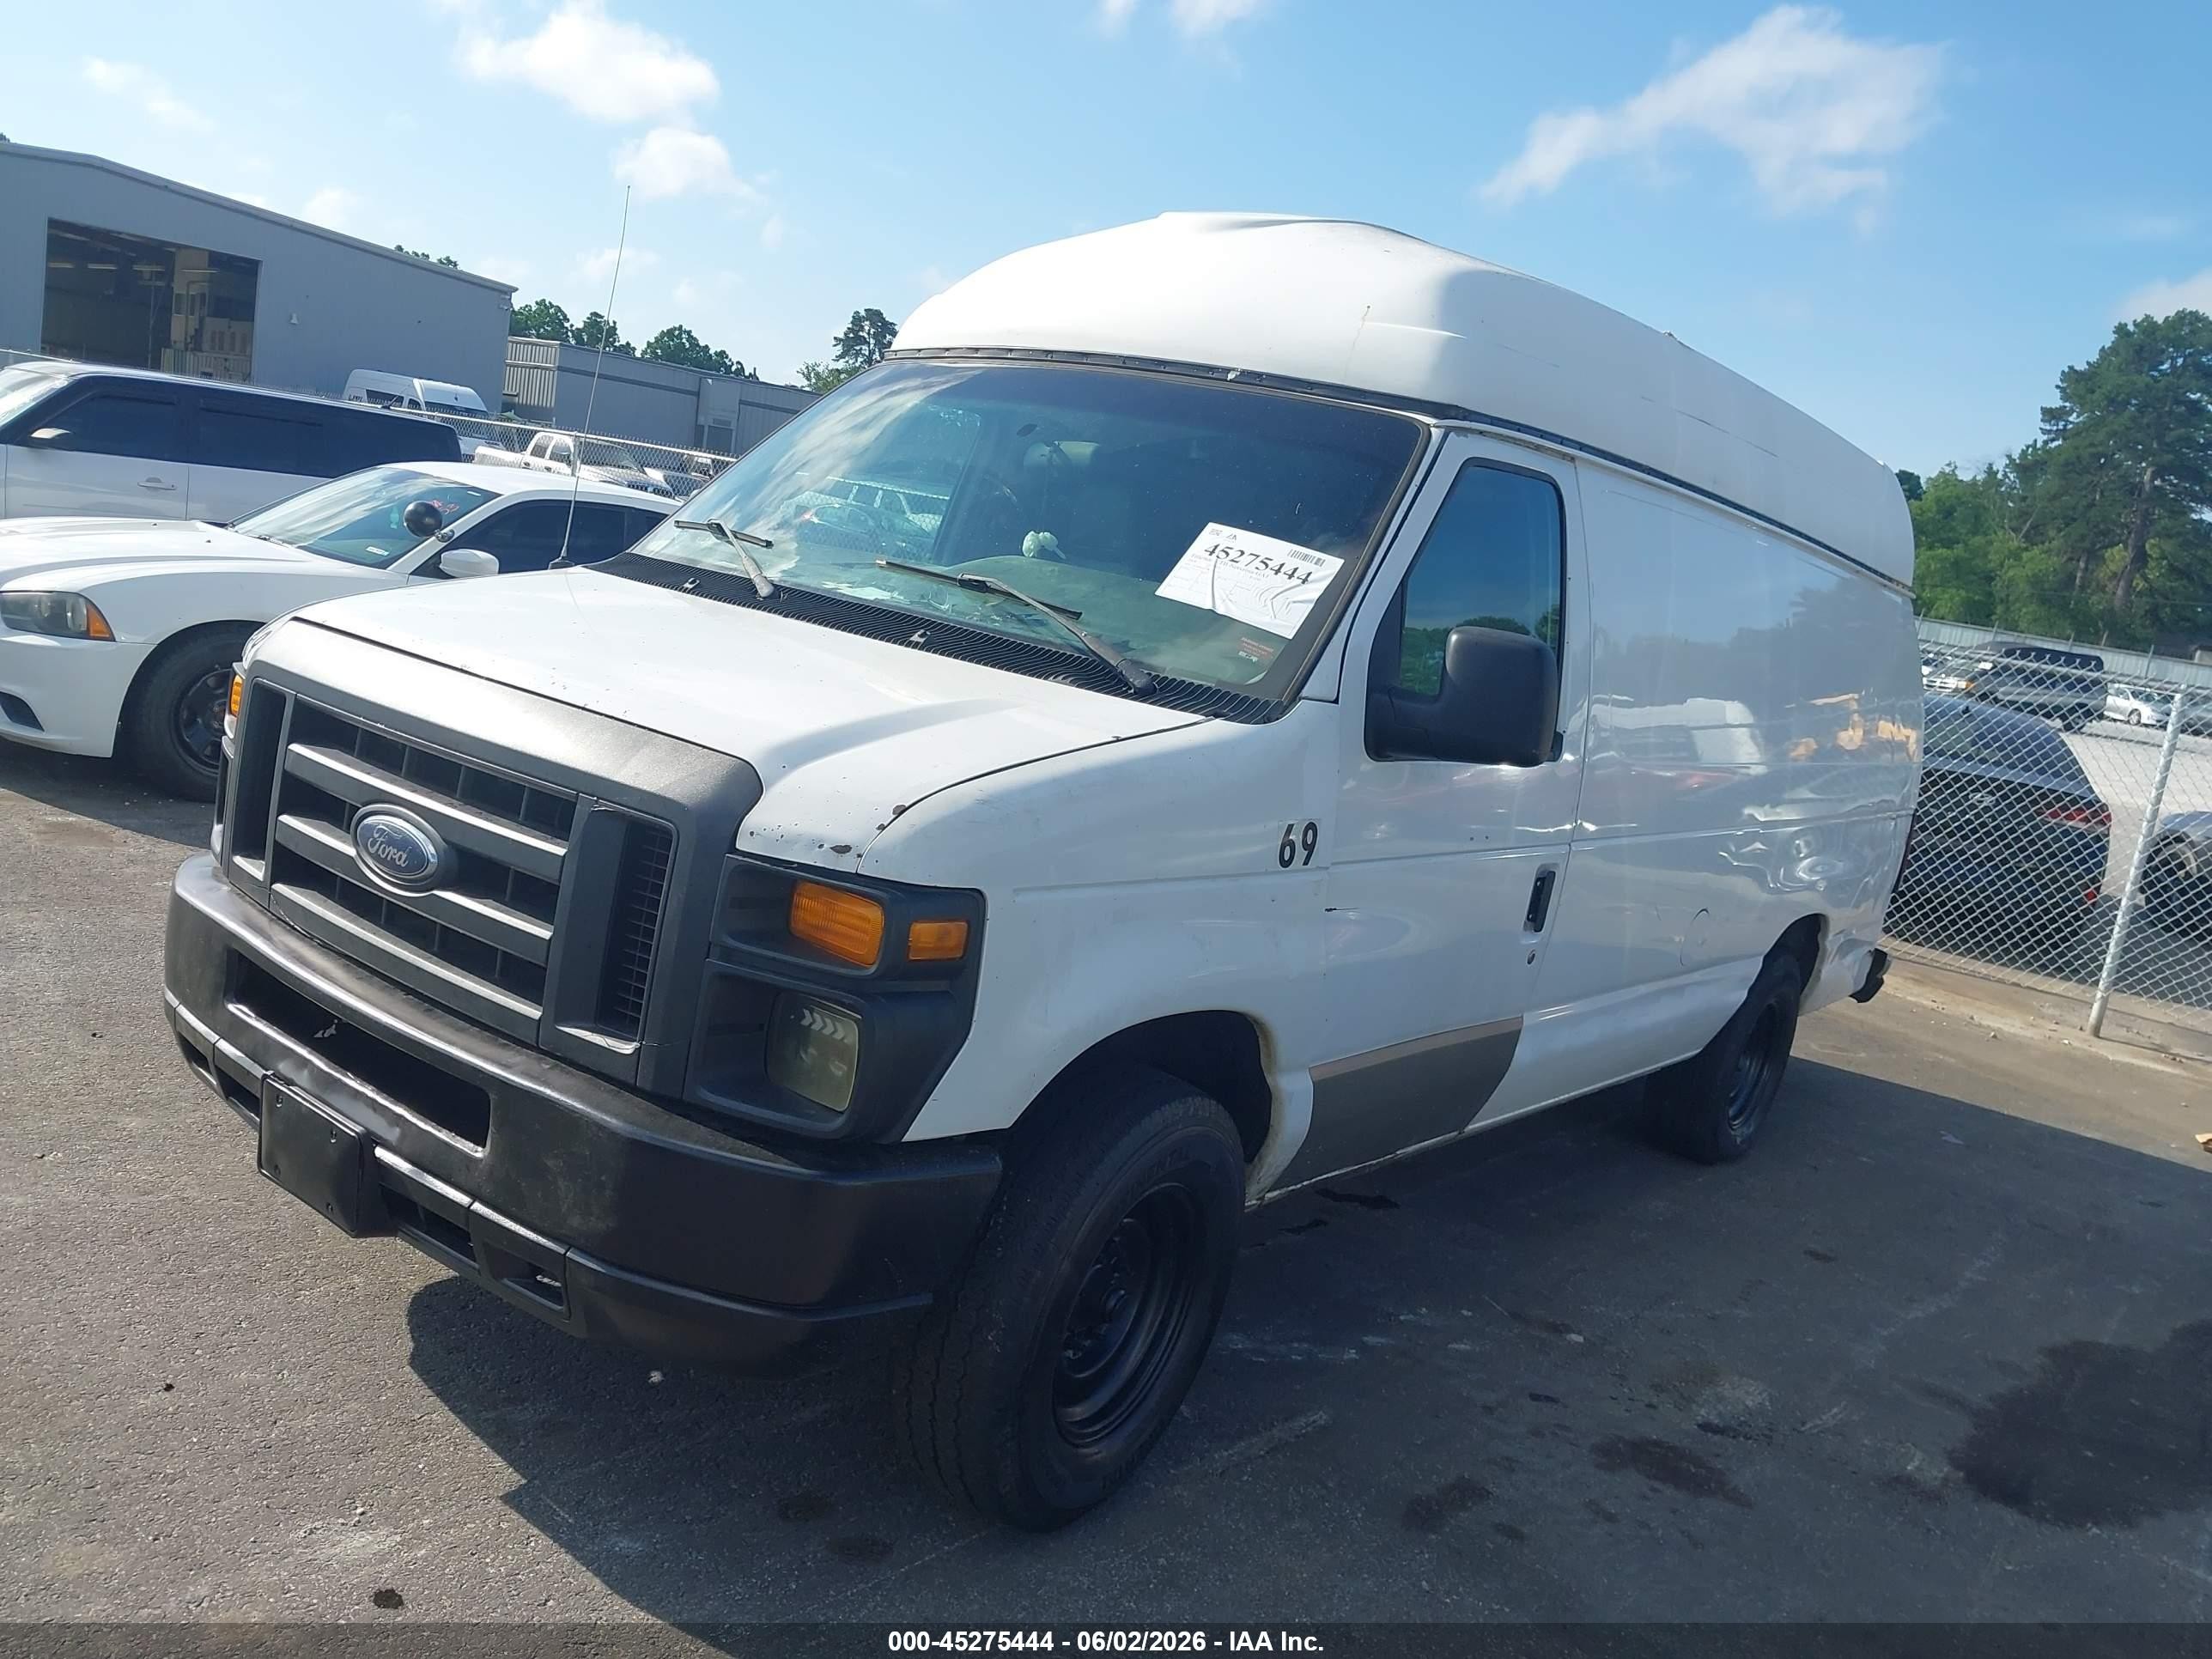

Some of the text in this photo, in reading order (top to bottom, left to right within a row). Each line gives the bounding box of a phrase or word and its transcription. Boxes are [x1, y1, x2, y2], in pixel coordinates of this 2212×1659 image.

[1204, 544, 1313, 585] 45275444
[368, 824, 413, 867] Ford
[1279, 822, 1318, 869] 69
